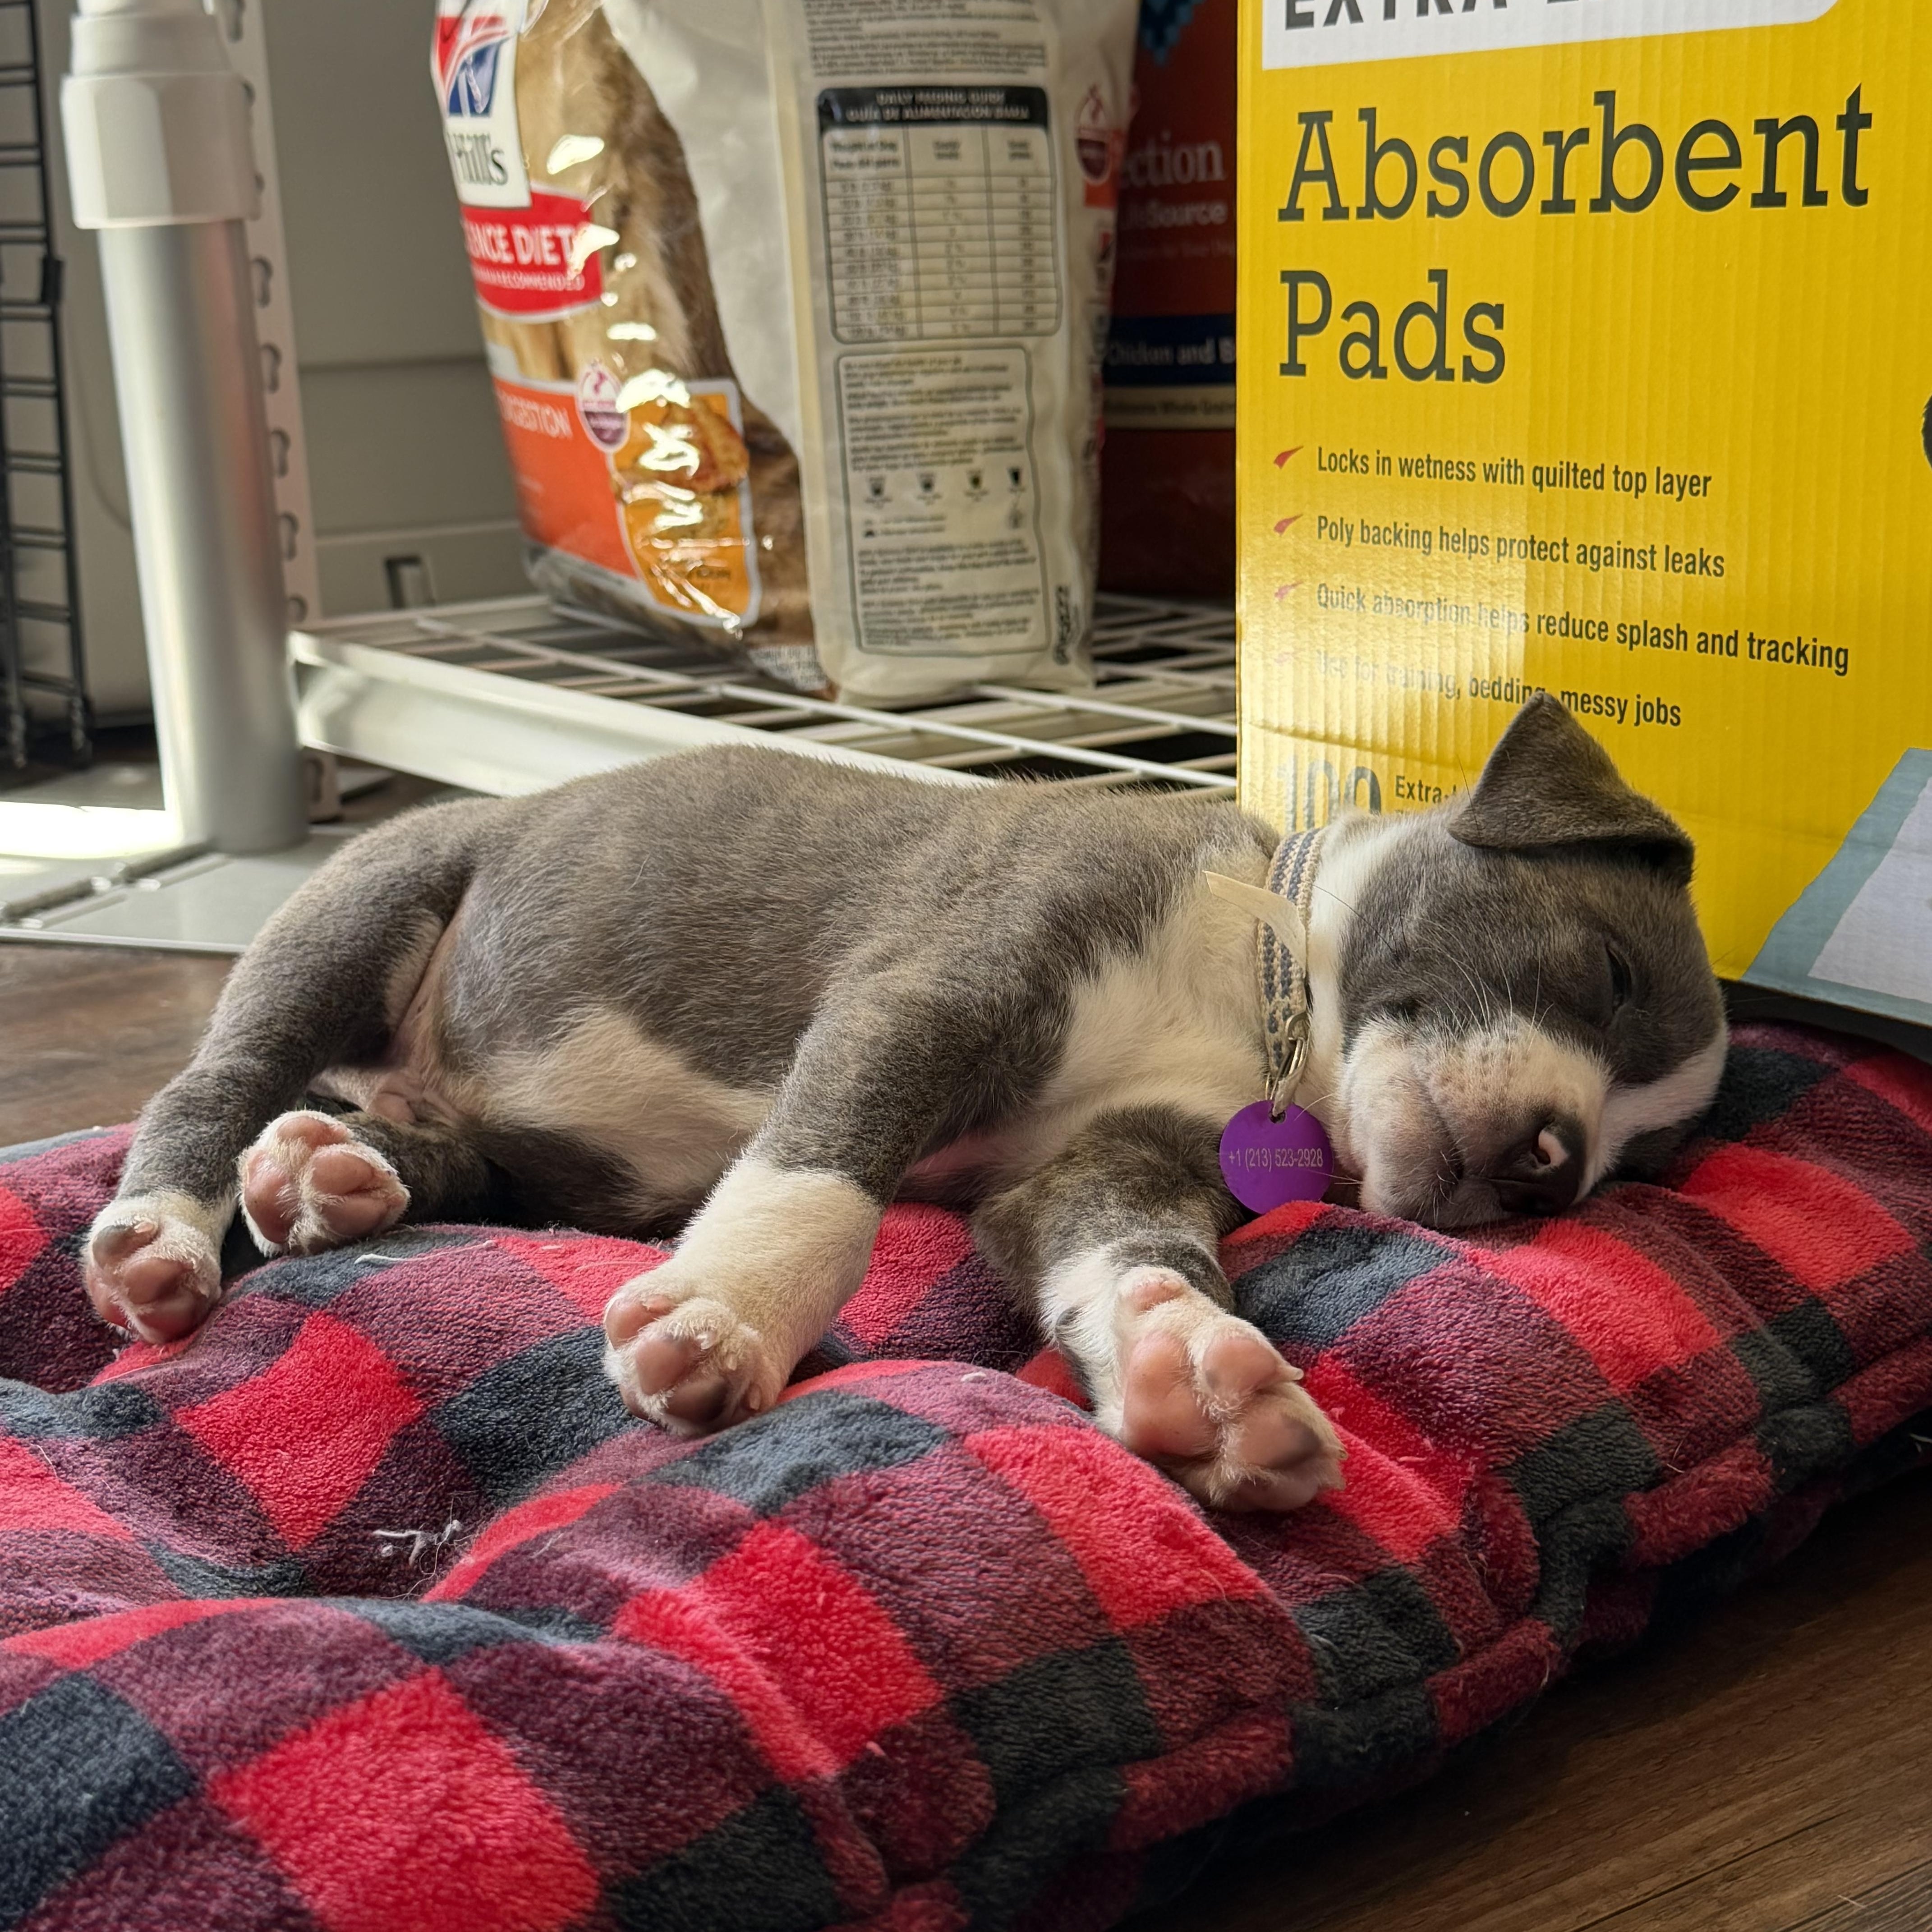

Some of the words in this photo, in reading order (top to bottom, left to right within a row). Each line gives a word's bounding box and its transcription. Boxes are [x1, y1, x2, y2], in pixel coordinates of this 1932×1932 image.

[1278, 83, 1872, 222] Absorbent
[510, 223, 575, 266] DIET
[1177, 336, 1216, 366] and
[1279, 268, 1506, 384] Pads
[1318, 446, 1369, 474] Locks
[1376, 449, 1392, 476] in
[1398, 453, 1476, 482] wetness
[1482, 457, 1524, 485] with
[1532, 460, 1605, 493] quilted
[1612, 464, 1647, 499] top
[1655, 466, 1712, 502] layer
[1318, 515, 1354, 548] Poly
[1360, 518, 1432, 556] backing
[1439, 525, 1490, 560] helps
[1496, 534, 1569, 563] protect
[1576, 540, 1657, 572] against
[1664, 544, 1725, 577] leaks
[1317, 583, 1366, 612] Quick
[1373, 591, 1470, 626] absorption
[1478, 602, 1529, 636] helps
[1537, 611, 1609, 642] reduce
[1616, 619, 1688, 651] splash
[1696, 630, 1738, 658] and
[1747, 632, 1849, 676] tracking
[1560, 689, 1628, 725] messy
[1634, 694, 1681, 727] jobs
[1228, 1149, 1241, 1167] +1
[1245, 1148, 1272, 1172] (213)
[1275, 1148, 1323, 1167] 523-2928
